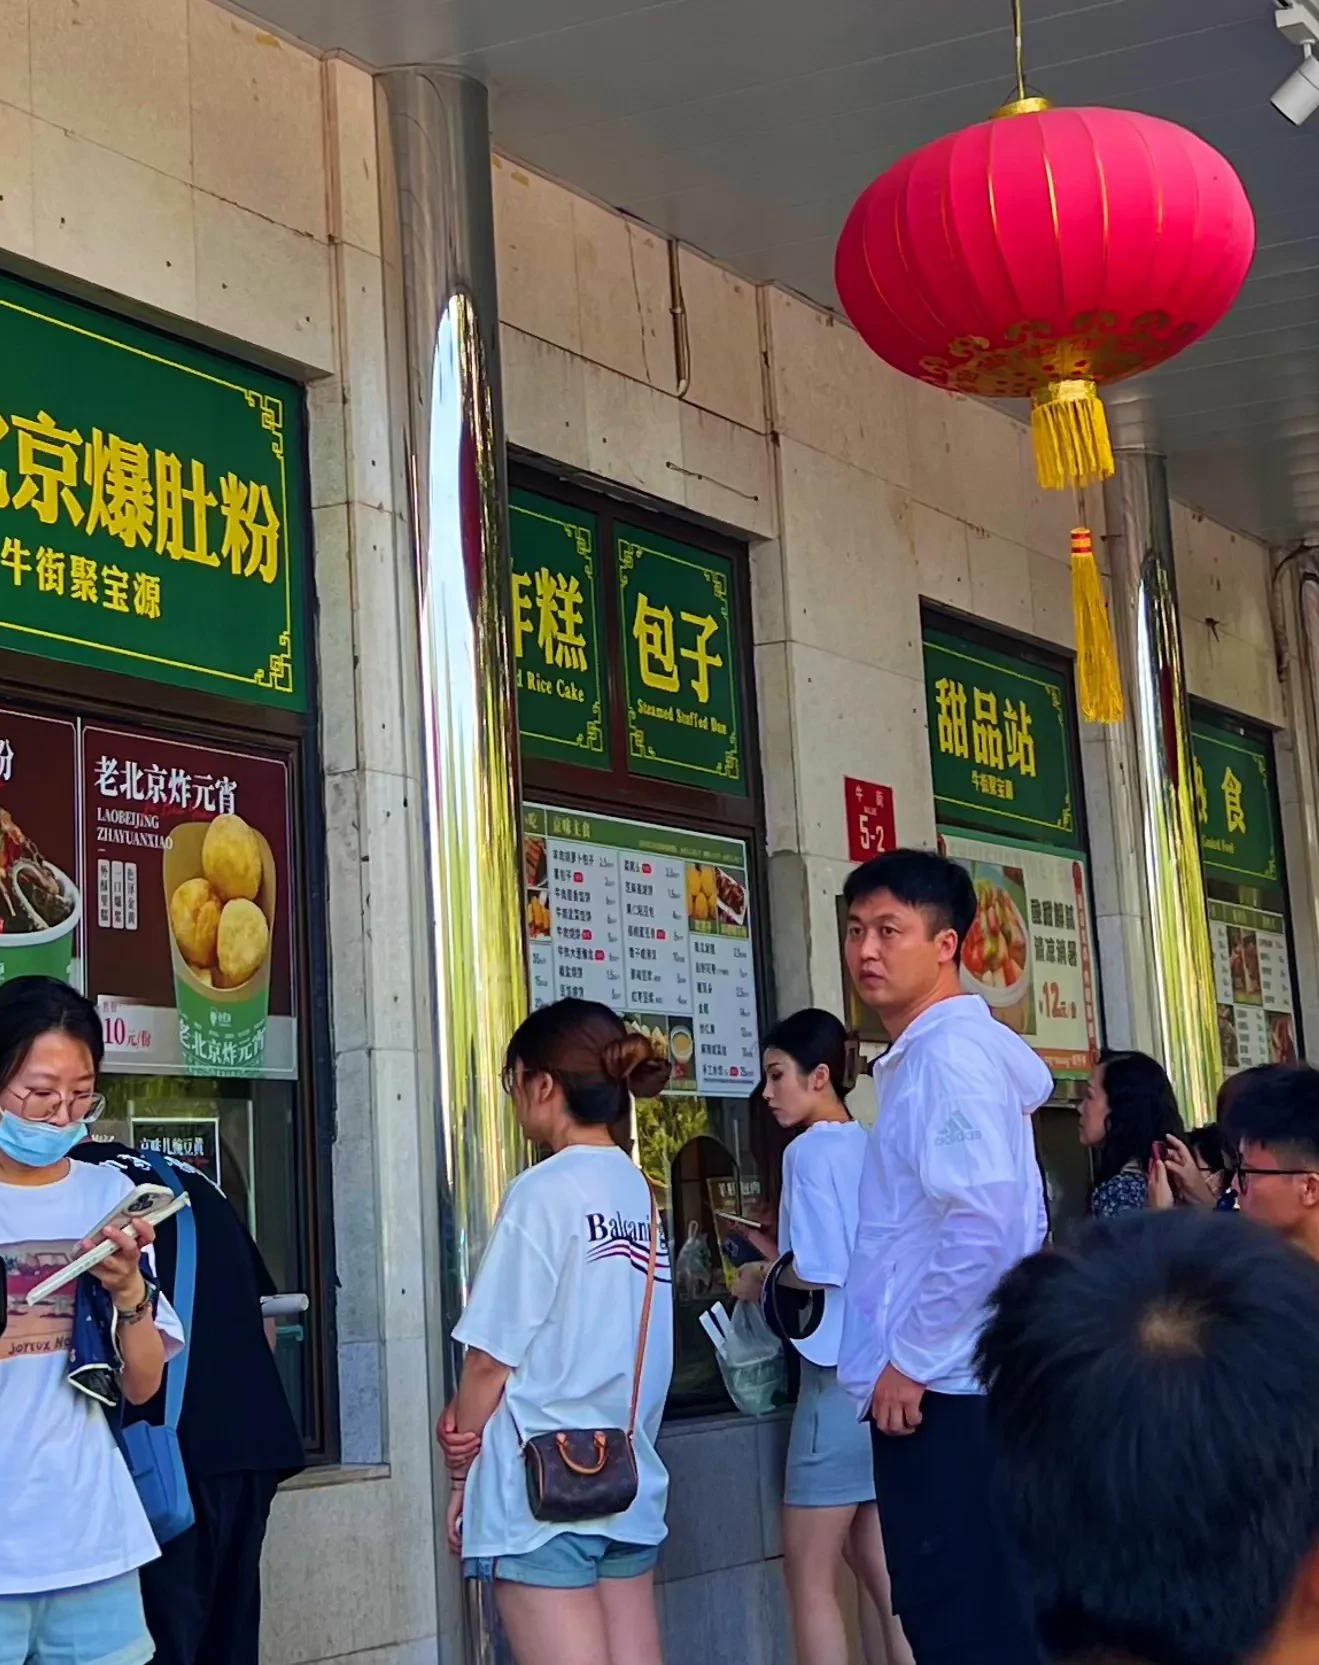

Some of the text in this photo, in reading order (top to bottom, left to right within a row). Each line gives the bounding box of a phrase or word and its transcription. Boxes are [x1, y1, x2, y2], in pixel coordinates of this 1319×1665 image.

[0, 536, 164, 620] 牛街聚宝源
[633, 592, 723, 704] 包子
[527, 671, 585, 702] Rice Cake
[934, 676, 1038, 778] 甜品站
[94, 755, 237, 814] 老北京炸元宵
[96, 827, 174, 851] ZHAYUANXIAO
[97, 807, 160, 829] LAOBEIJING
[859, 814, 885, 852] 5-2
